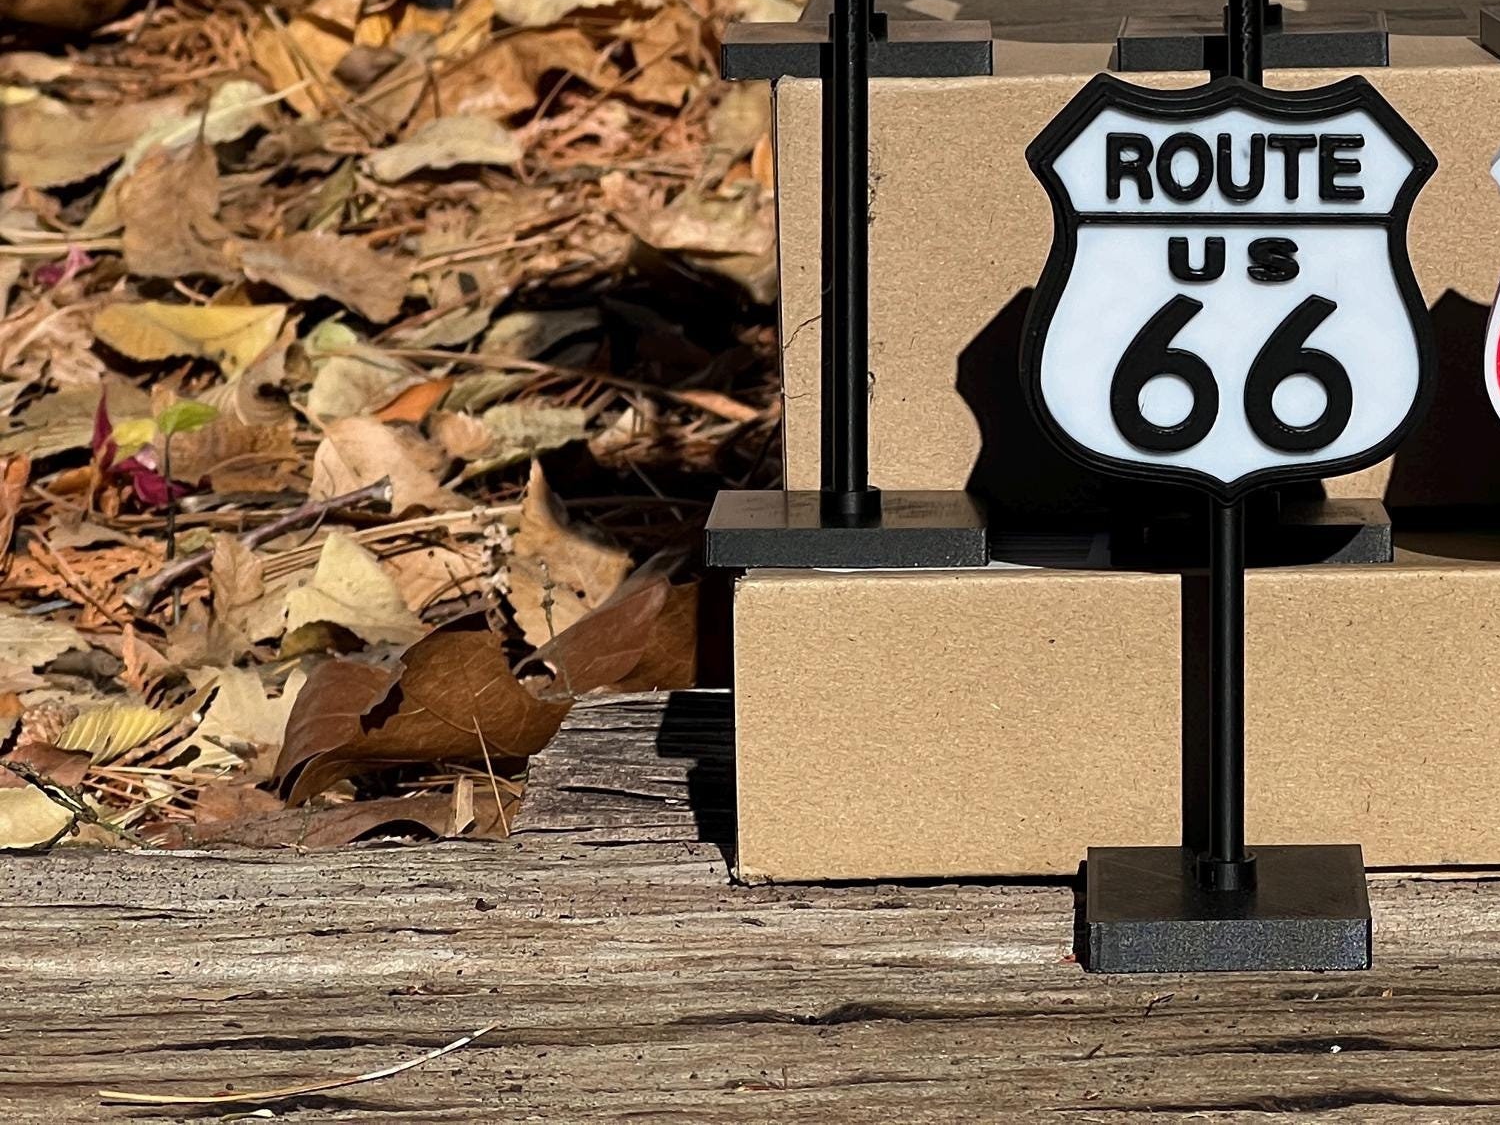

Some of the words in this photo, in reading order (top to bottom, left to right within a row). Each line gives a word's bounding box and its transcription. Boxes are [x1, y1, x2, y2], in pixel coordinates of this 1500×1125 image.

[1105, 132, 1366, 204] ROUTE
[1167, 236, 1301, 285] US
[1109, 293, 1353, 453] 66
